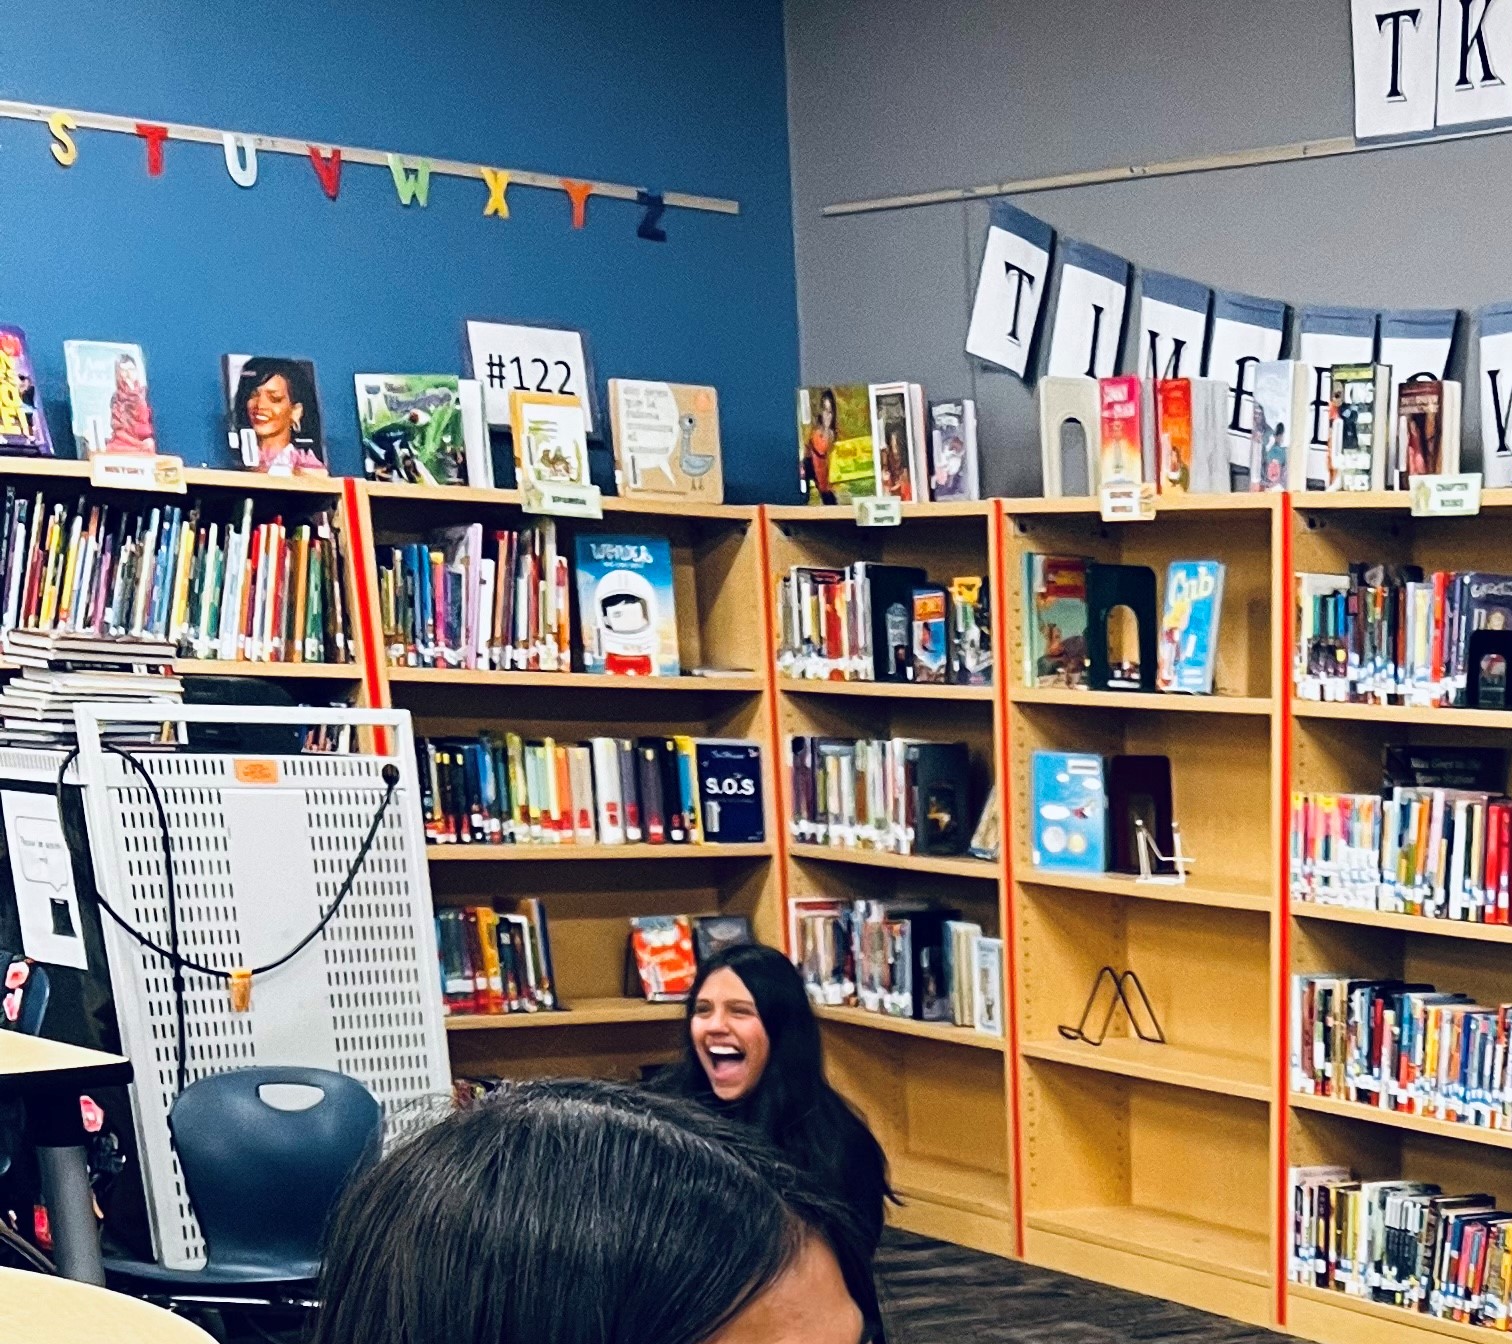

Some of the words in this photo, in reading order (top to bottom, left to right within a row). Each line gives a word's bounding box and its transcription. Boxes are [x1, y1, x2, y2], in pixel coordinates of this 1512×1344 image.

[48, 112, 77, 166] S
[135, 123, 168, 176] T
[222, 133, 258, 187] U
[307, 145, 341, 199] V
[387, 153, 430, 207] W
[480, 168, 511, 218] X
[560, 179, 593, 229] Y
[637, 189, 667, 242] Z
[486, 353, 575, 395] #122
